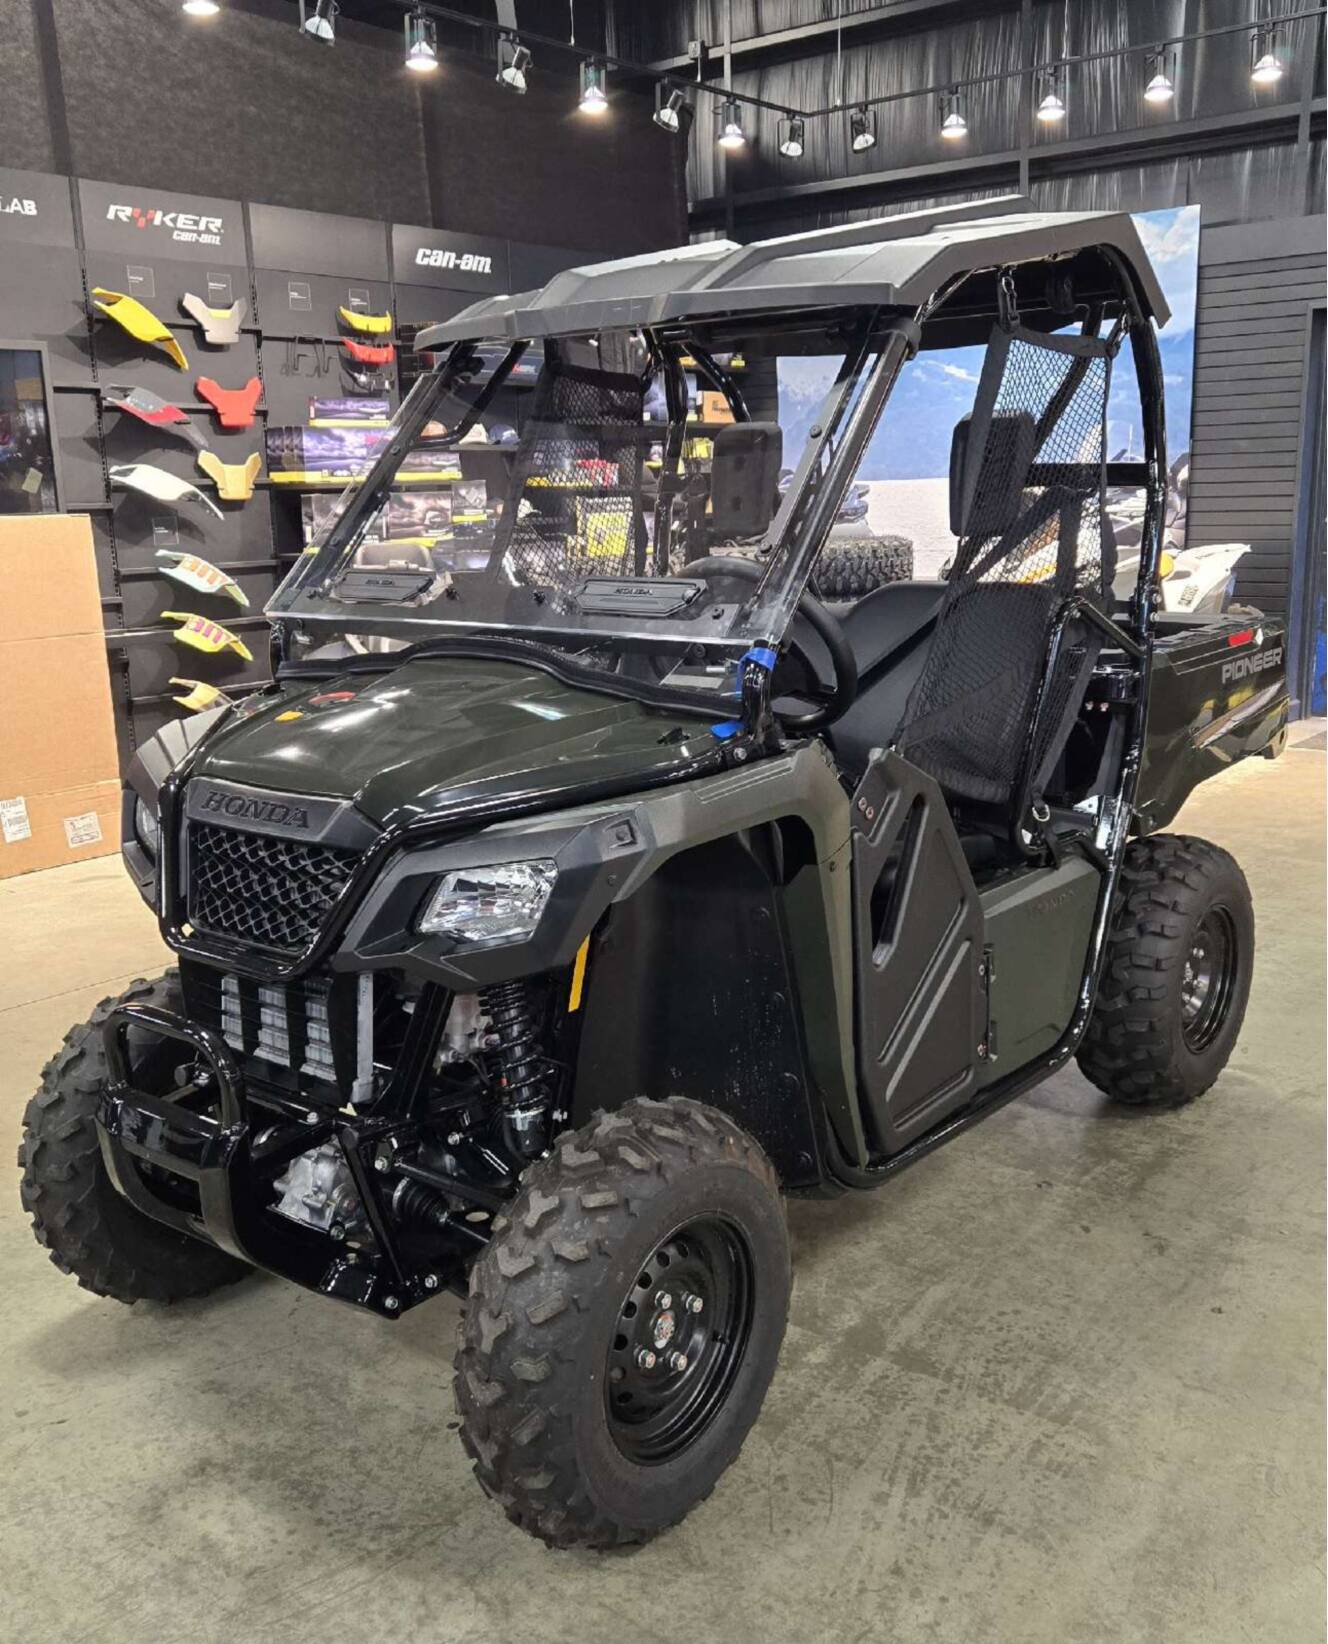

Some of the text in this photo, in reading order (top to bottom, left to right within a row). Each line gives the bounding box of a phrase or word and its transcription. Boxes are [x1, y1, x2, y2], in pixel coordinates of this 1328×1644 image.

[106, 204, 223, 233] RYKER
[415, 247, 492, 274] can-am
[1221, 647, 1282, 684] PIONEER
[201, 791, 309, 829] HONDA
